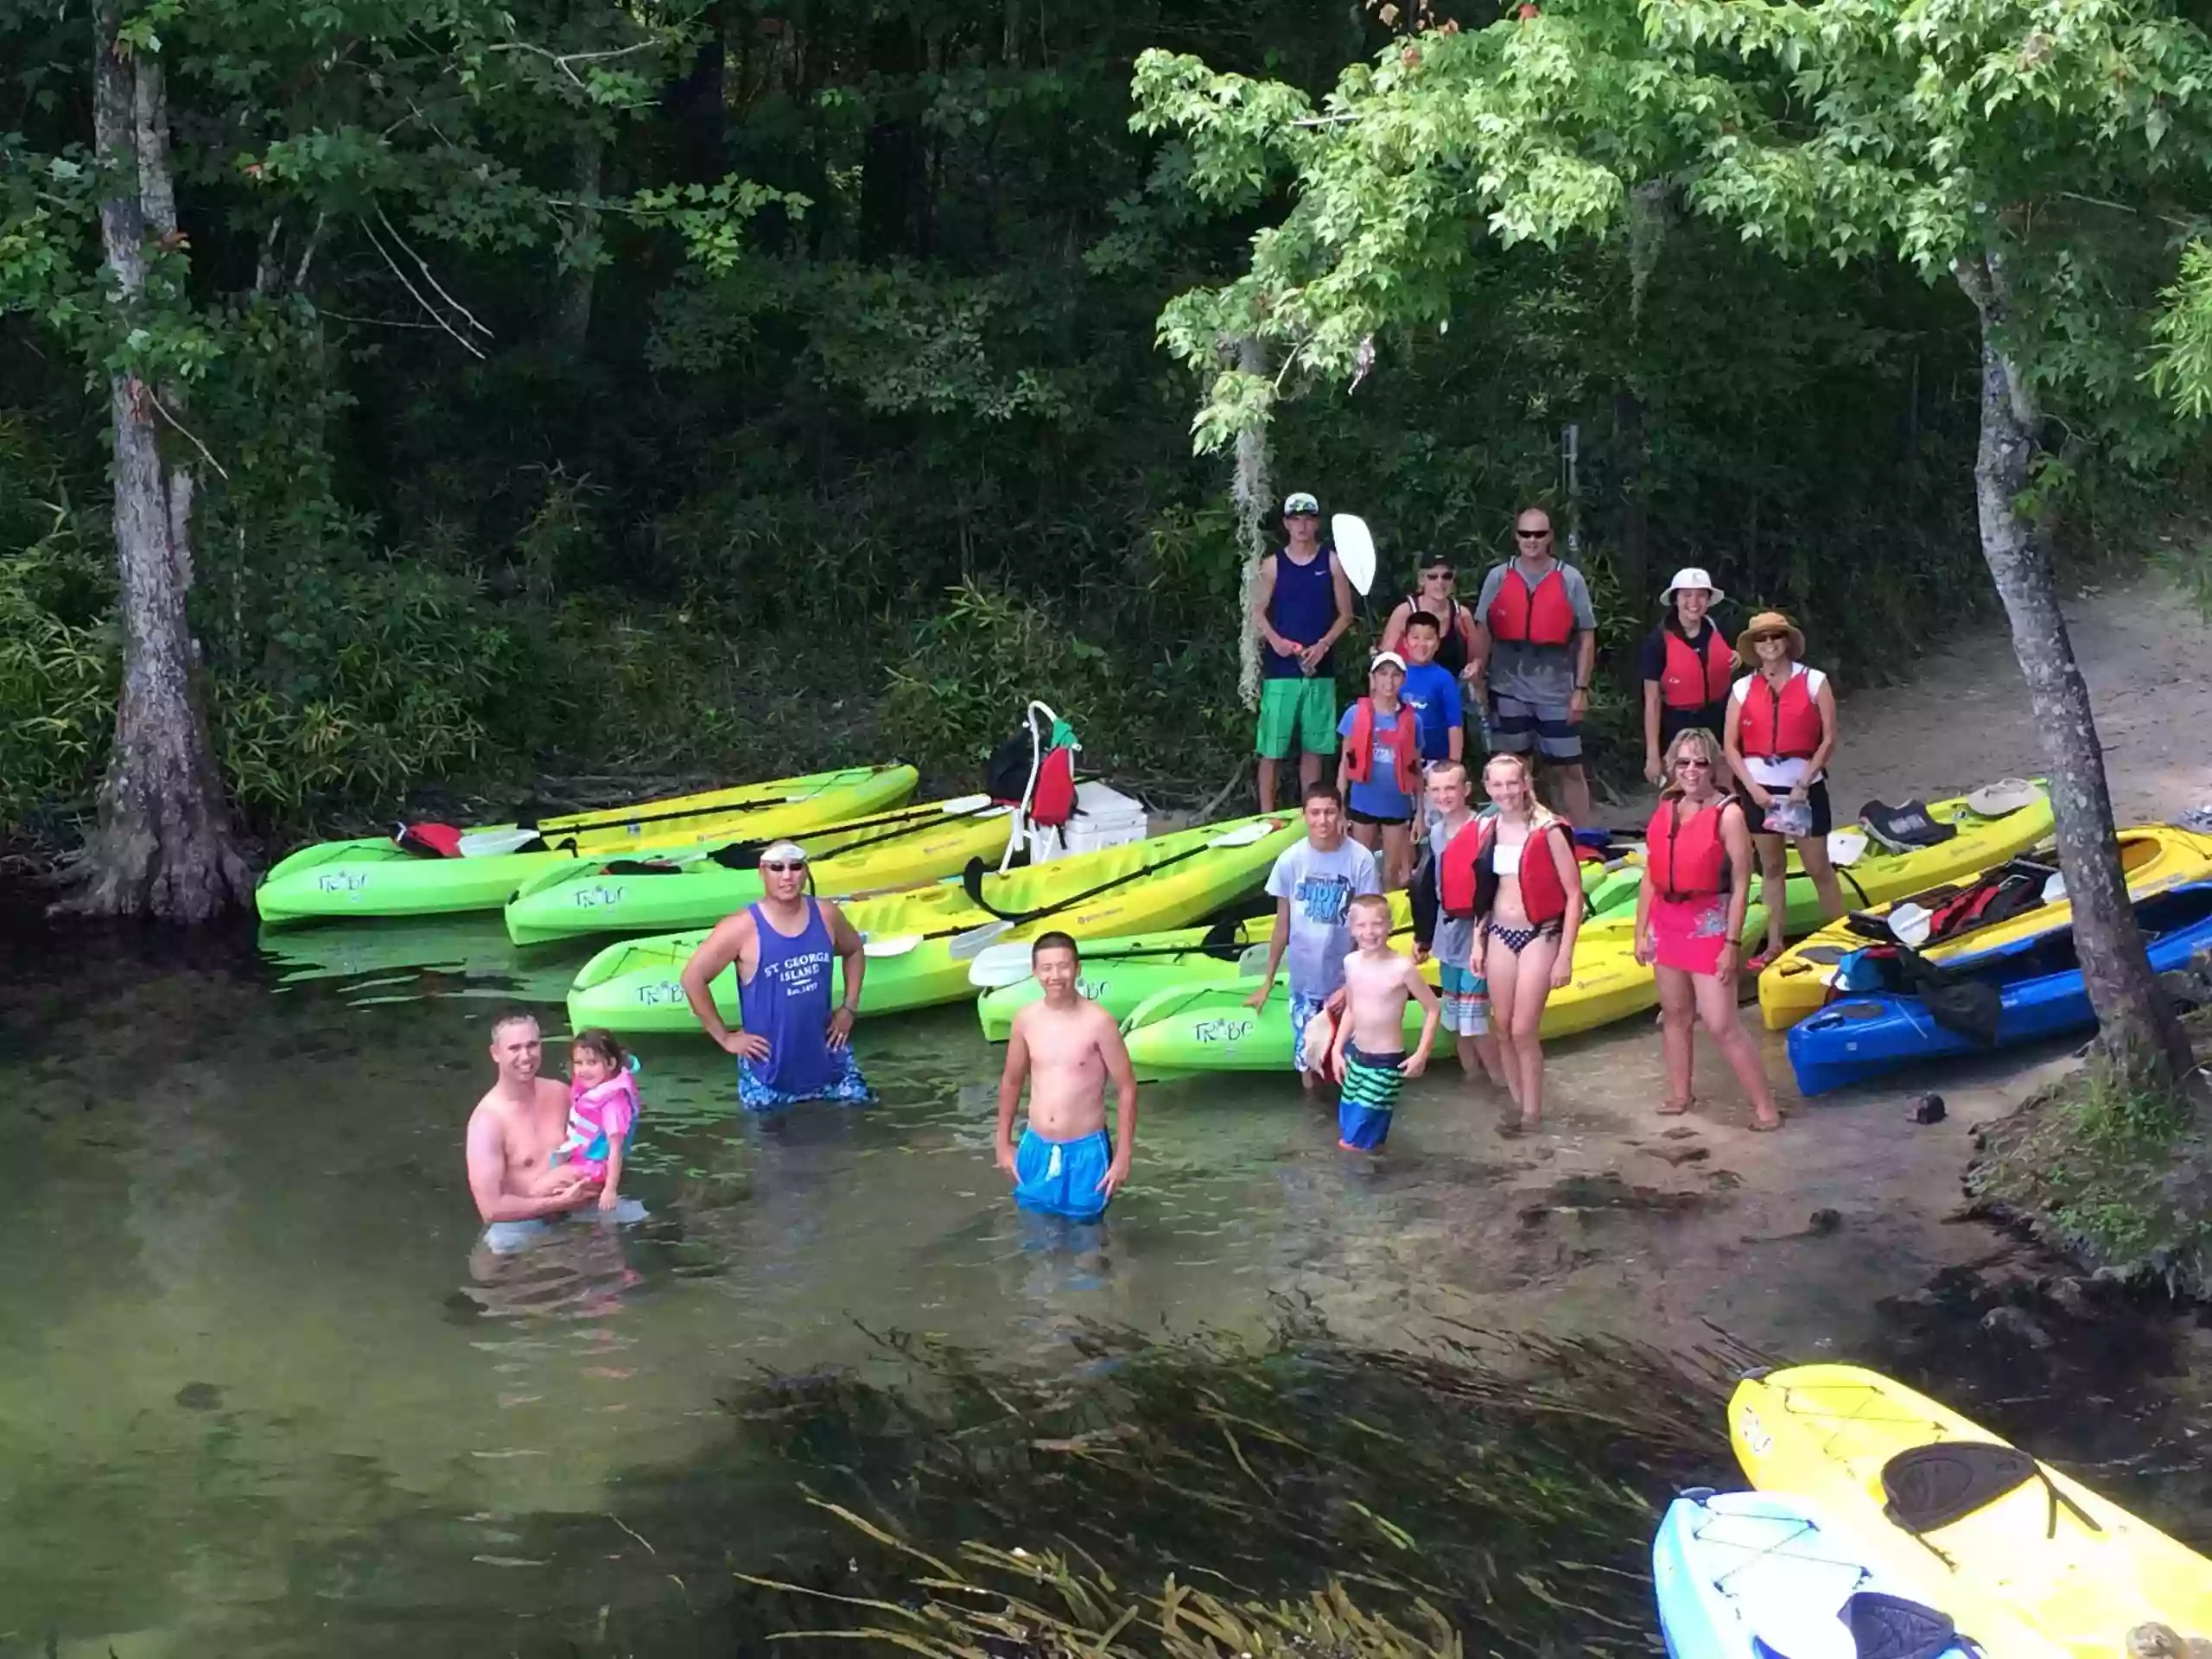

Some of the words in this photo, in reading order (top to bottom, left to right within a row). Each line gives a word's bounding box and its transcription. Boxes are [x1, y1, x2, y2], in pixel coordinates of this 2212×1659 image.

[764, 963, 779, 977] ST
[785, 952, 830, 969] GEORGE
[779, 963, 820, 982] ISLAND
